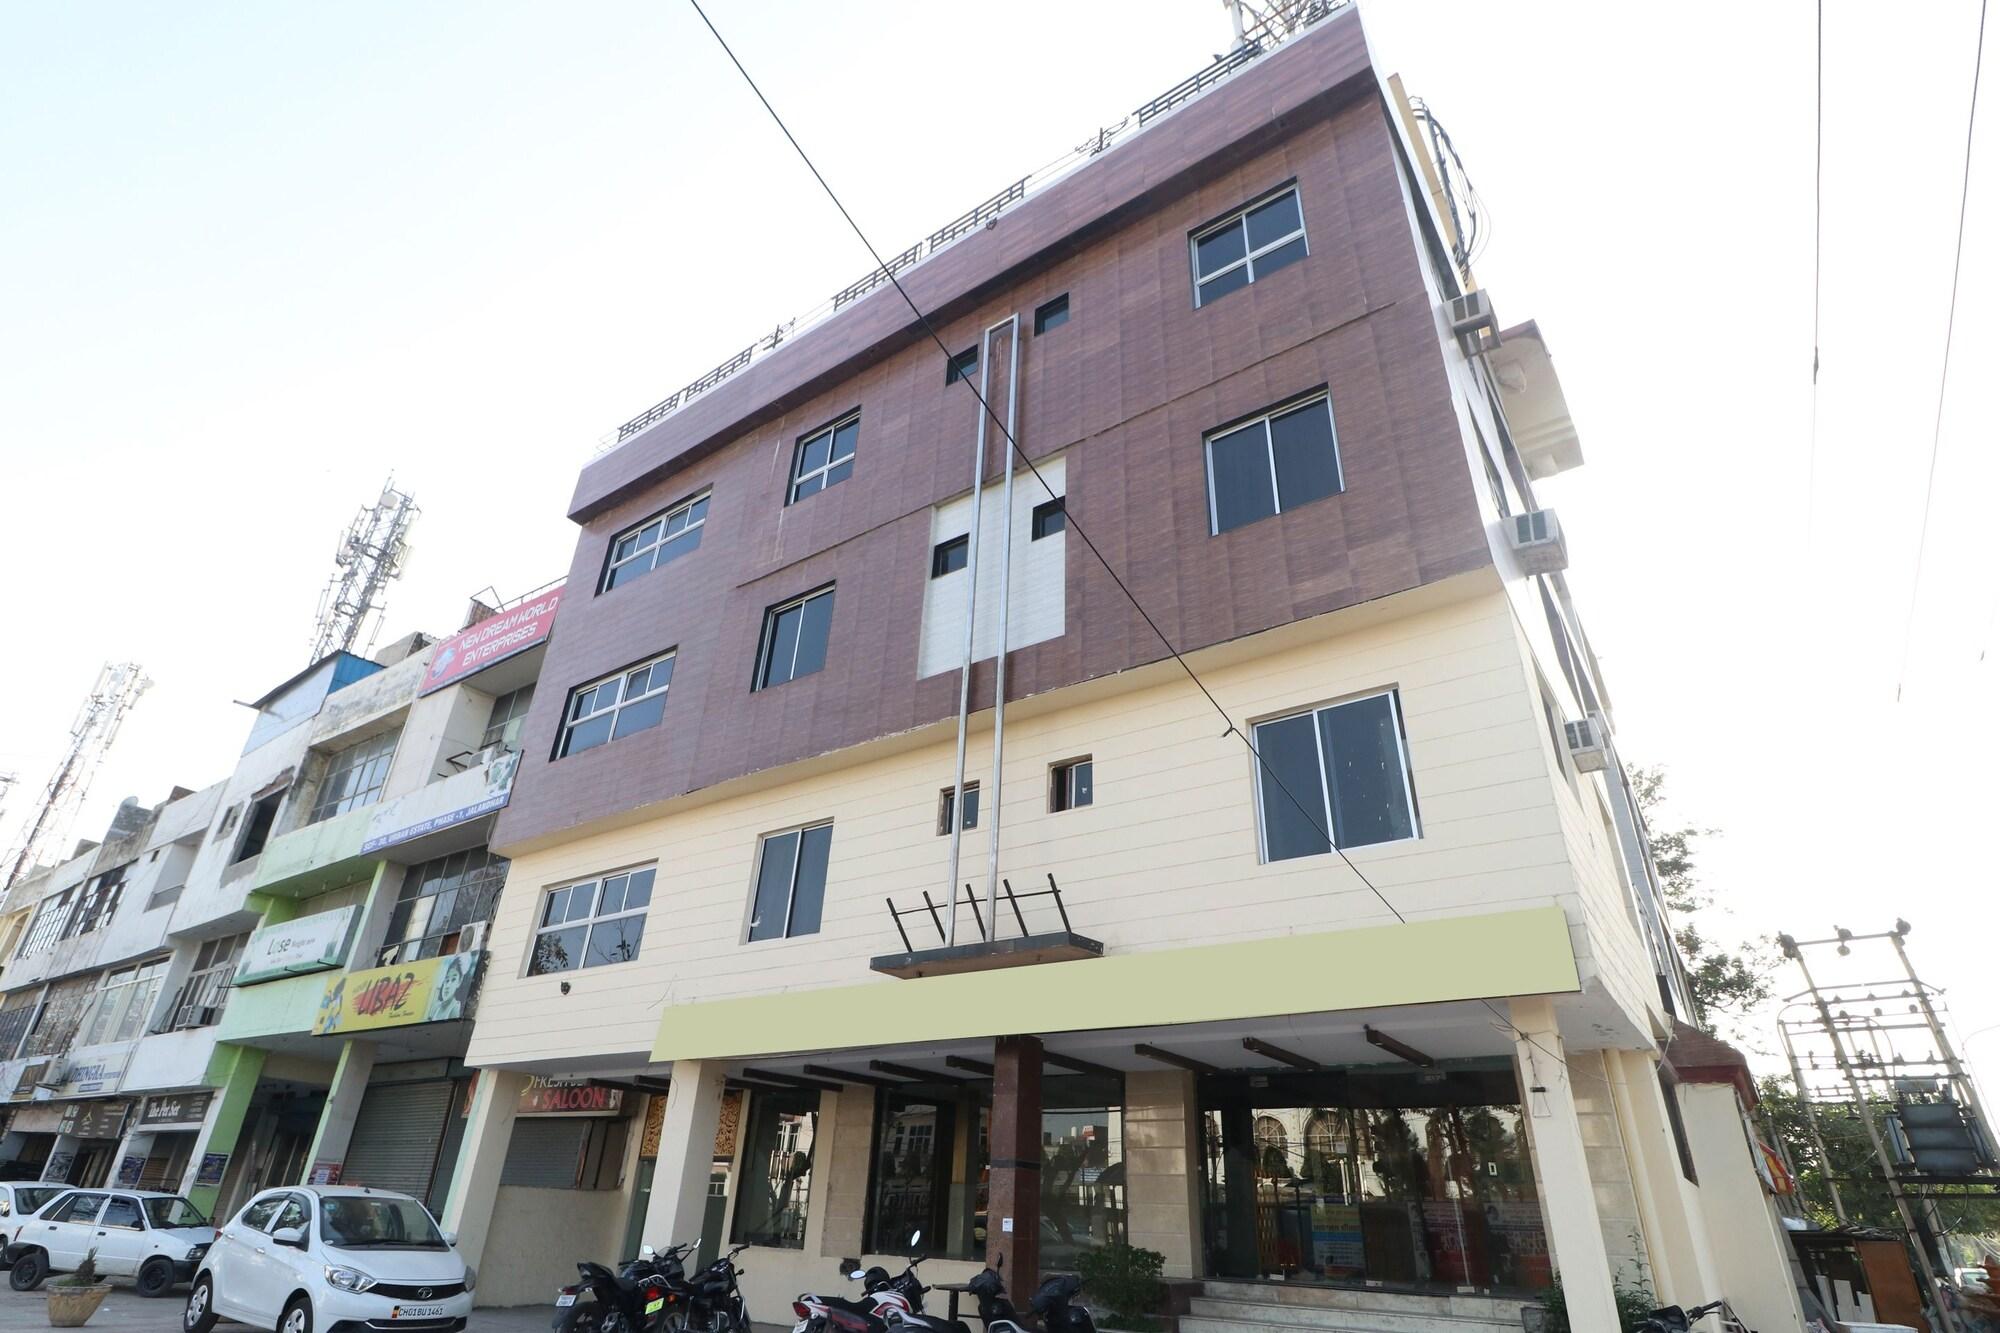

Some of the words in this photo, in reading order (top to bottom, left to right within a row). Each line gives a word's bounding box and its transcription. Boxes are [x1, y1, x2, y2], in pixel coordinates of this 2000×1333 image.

[459, 630, 483, 650] NEW
[481, 613, 518, 641] DREAM
[518, 597, 559, 622] WORLD
[462, 622, 538, 666] ENTERPRISES
[433, 813, 456, 828] PHASE
[466, 796, 505, 817] JALANDHAR
[542, 1087, 606, 1110] SALOON
